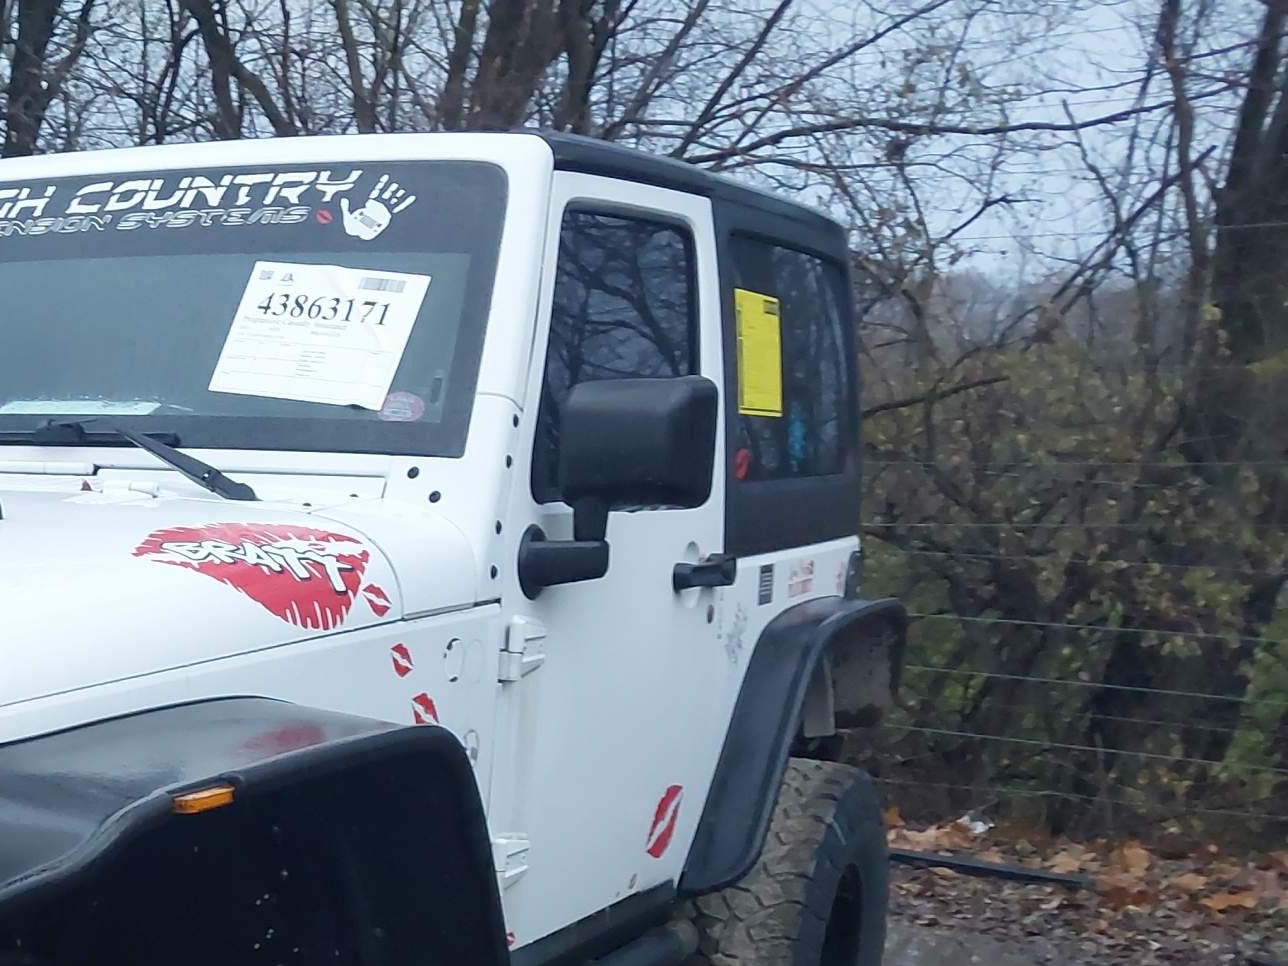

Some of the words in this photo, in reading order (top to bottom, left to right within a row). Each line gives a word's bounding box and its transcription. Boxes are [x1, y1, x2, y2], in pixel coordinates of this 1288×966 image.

[65, 170, 363, 214] COUNTRY
[116, 205, 312, 230] SYSTEMS
[257, 292, 391, 326] 43863171
